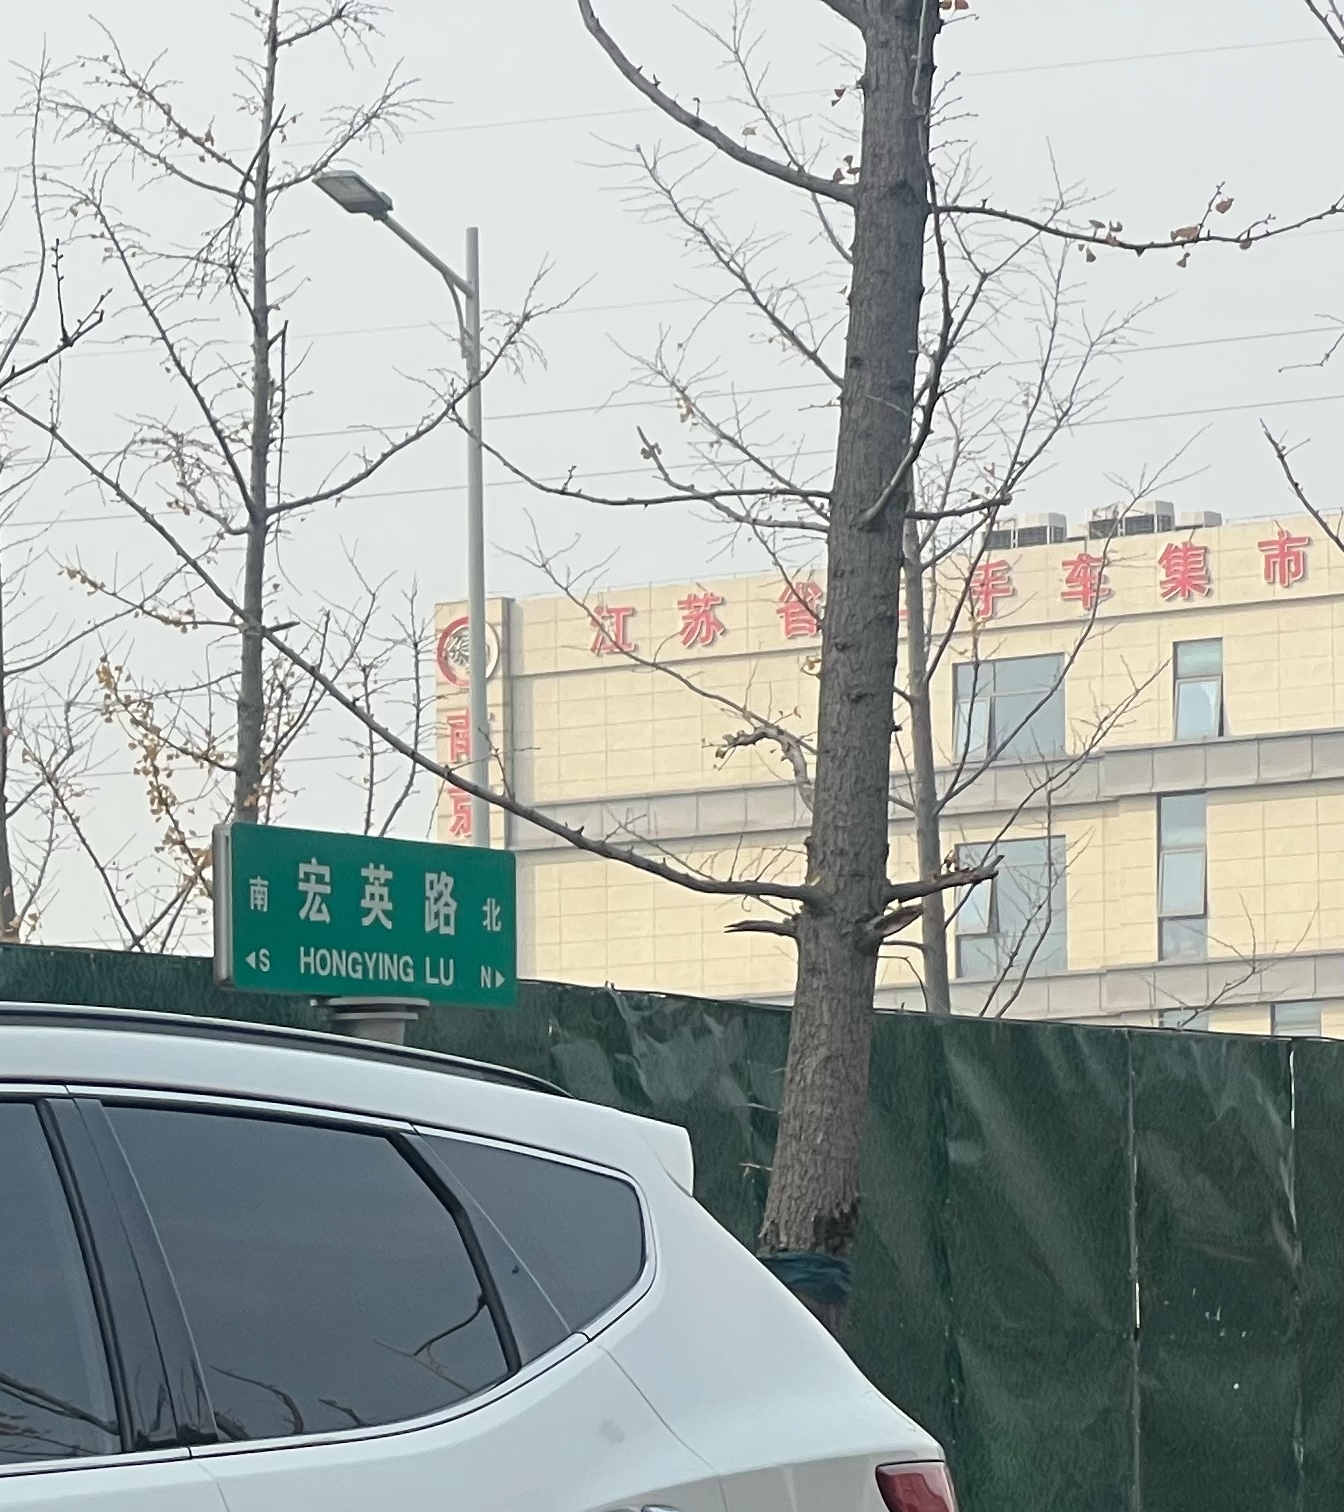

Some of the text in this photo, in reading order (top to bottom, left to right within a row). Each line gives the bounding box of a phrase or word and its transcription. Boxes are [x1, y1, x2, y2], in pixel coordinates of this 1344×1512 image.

[589, 530, 1311, 656] 江苏省手车集市
[248, 857, 502, 936] 南 宏英路 北
[258, 946, 493, 989] S HONGYING LU N
